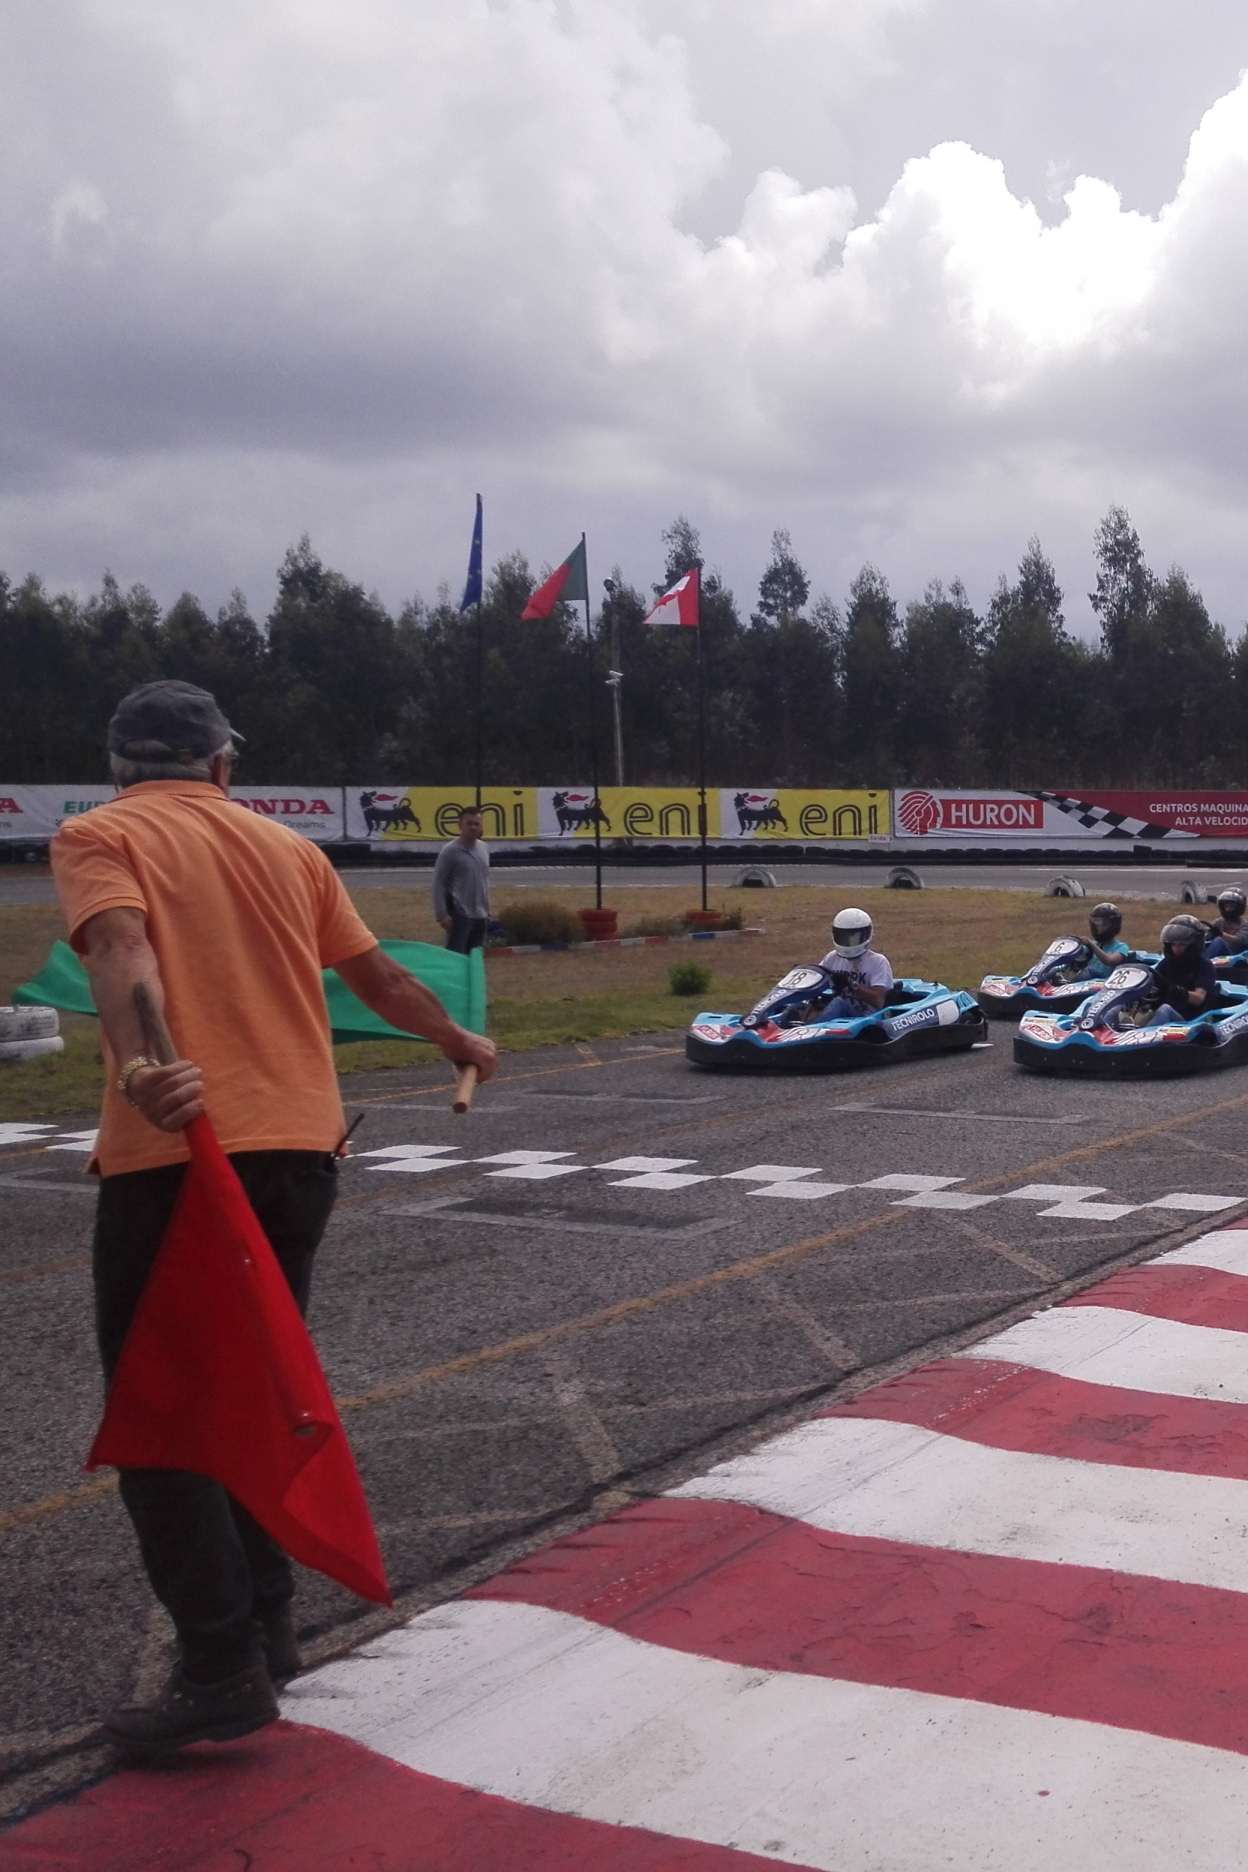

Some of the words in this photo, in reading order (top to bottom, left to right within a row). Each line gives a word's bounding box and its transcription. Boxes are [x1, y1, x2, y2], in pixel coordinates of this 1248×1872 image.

[229, 798, 335, 814] NDA
[1149, 803, 1198, 813] CENTROS
[800, 793, 878, 836] eni
[951, 803, 1035, 825] HURON
[1175, 816, 1202, 826] ALTA
[1055, 941, 1066, 953] 6
[786, 971, 808, 986] 18
[1109, 970, 1130, 985] 26
[891, 1008, 936, 1032] TECNIROLO
